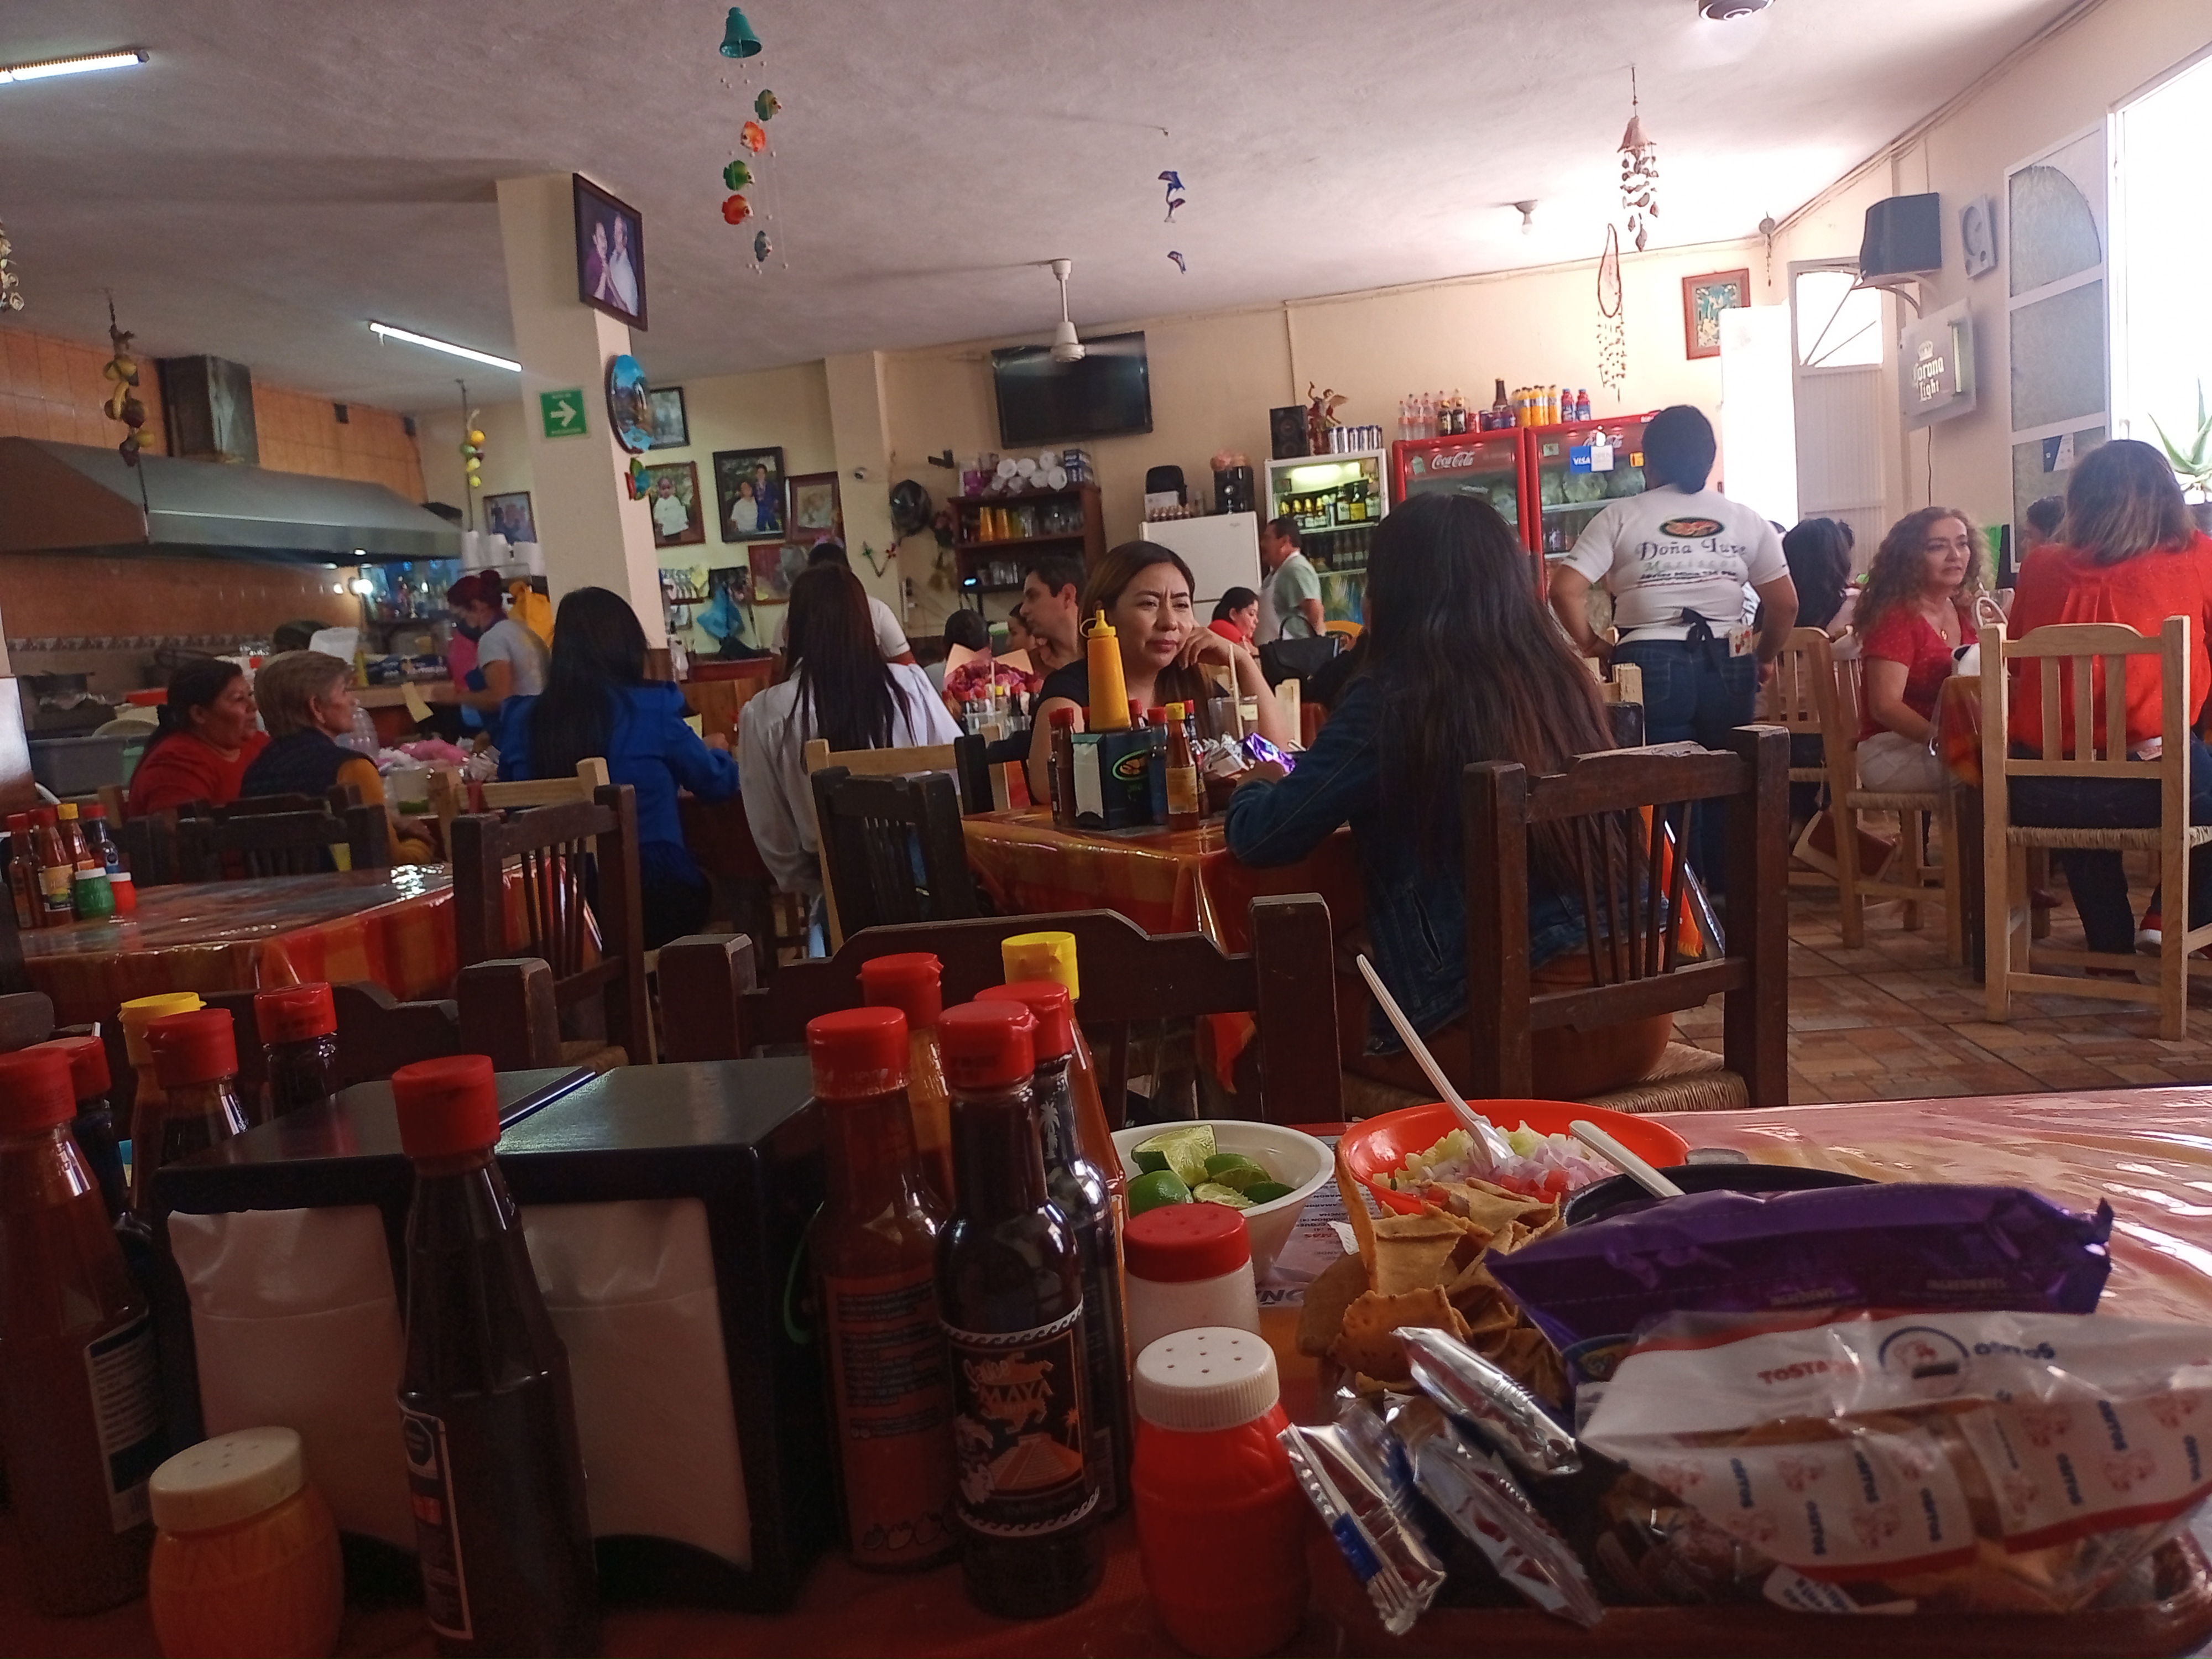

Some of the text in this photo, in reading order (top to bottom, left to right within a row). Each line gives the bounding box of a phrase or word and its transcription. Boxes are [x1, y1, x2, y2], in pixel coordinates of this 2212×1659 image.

[1912, 356, 1945, 388] Corona
[1919, 378, 1940, 401] Light
[1431, 450, 1475, 470] Coca-Cola
[1573, 456, 1591, 466] VISA
[1635, 541, 1692, 561] Doña
[979, 1378, 1054, 1403] MAYA
